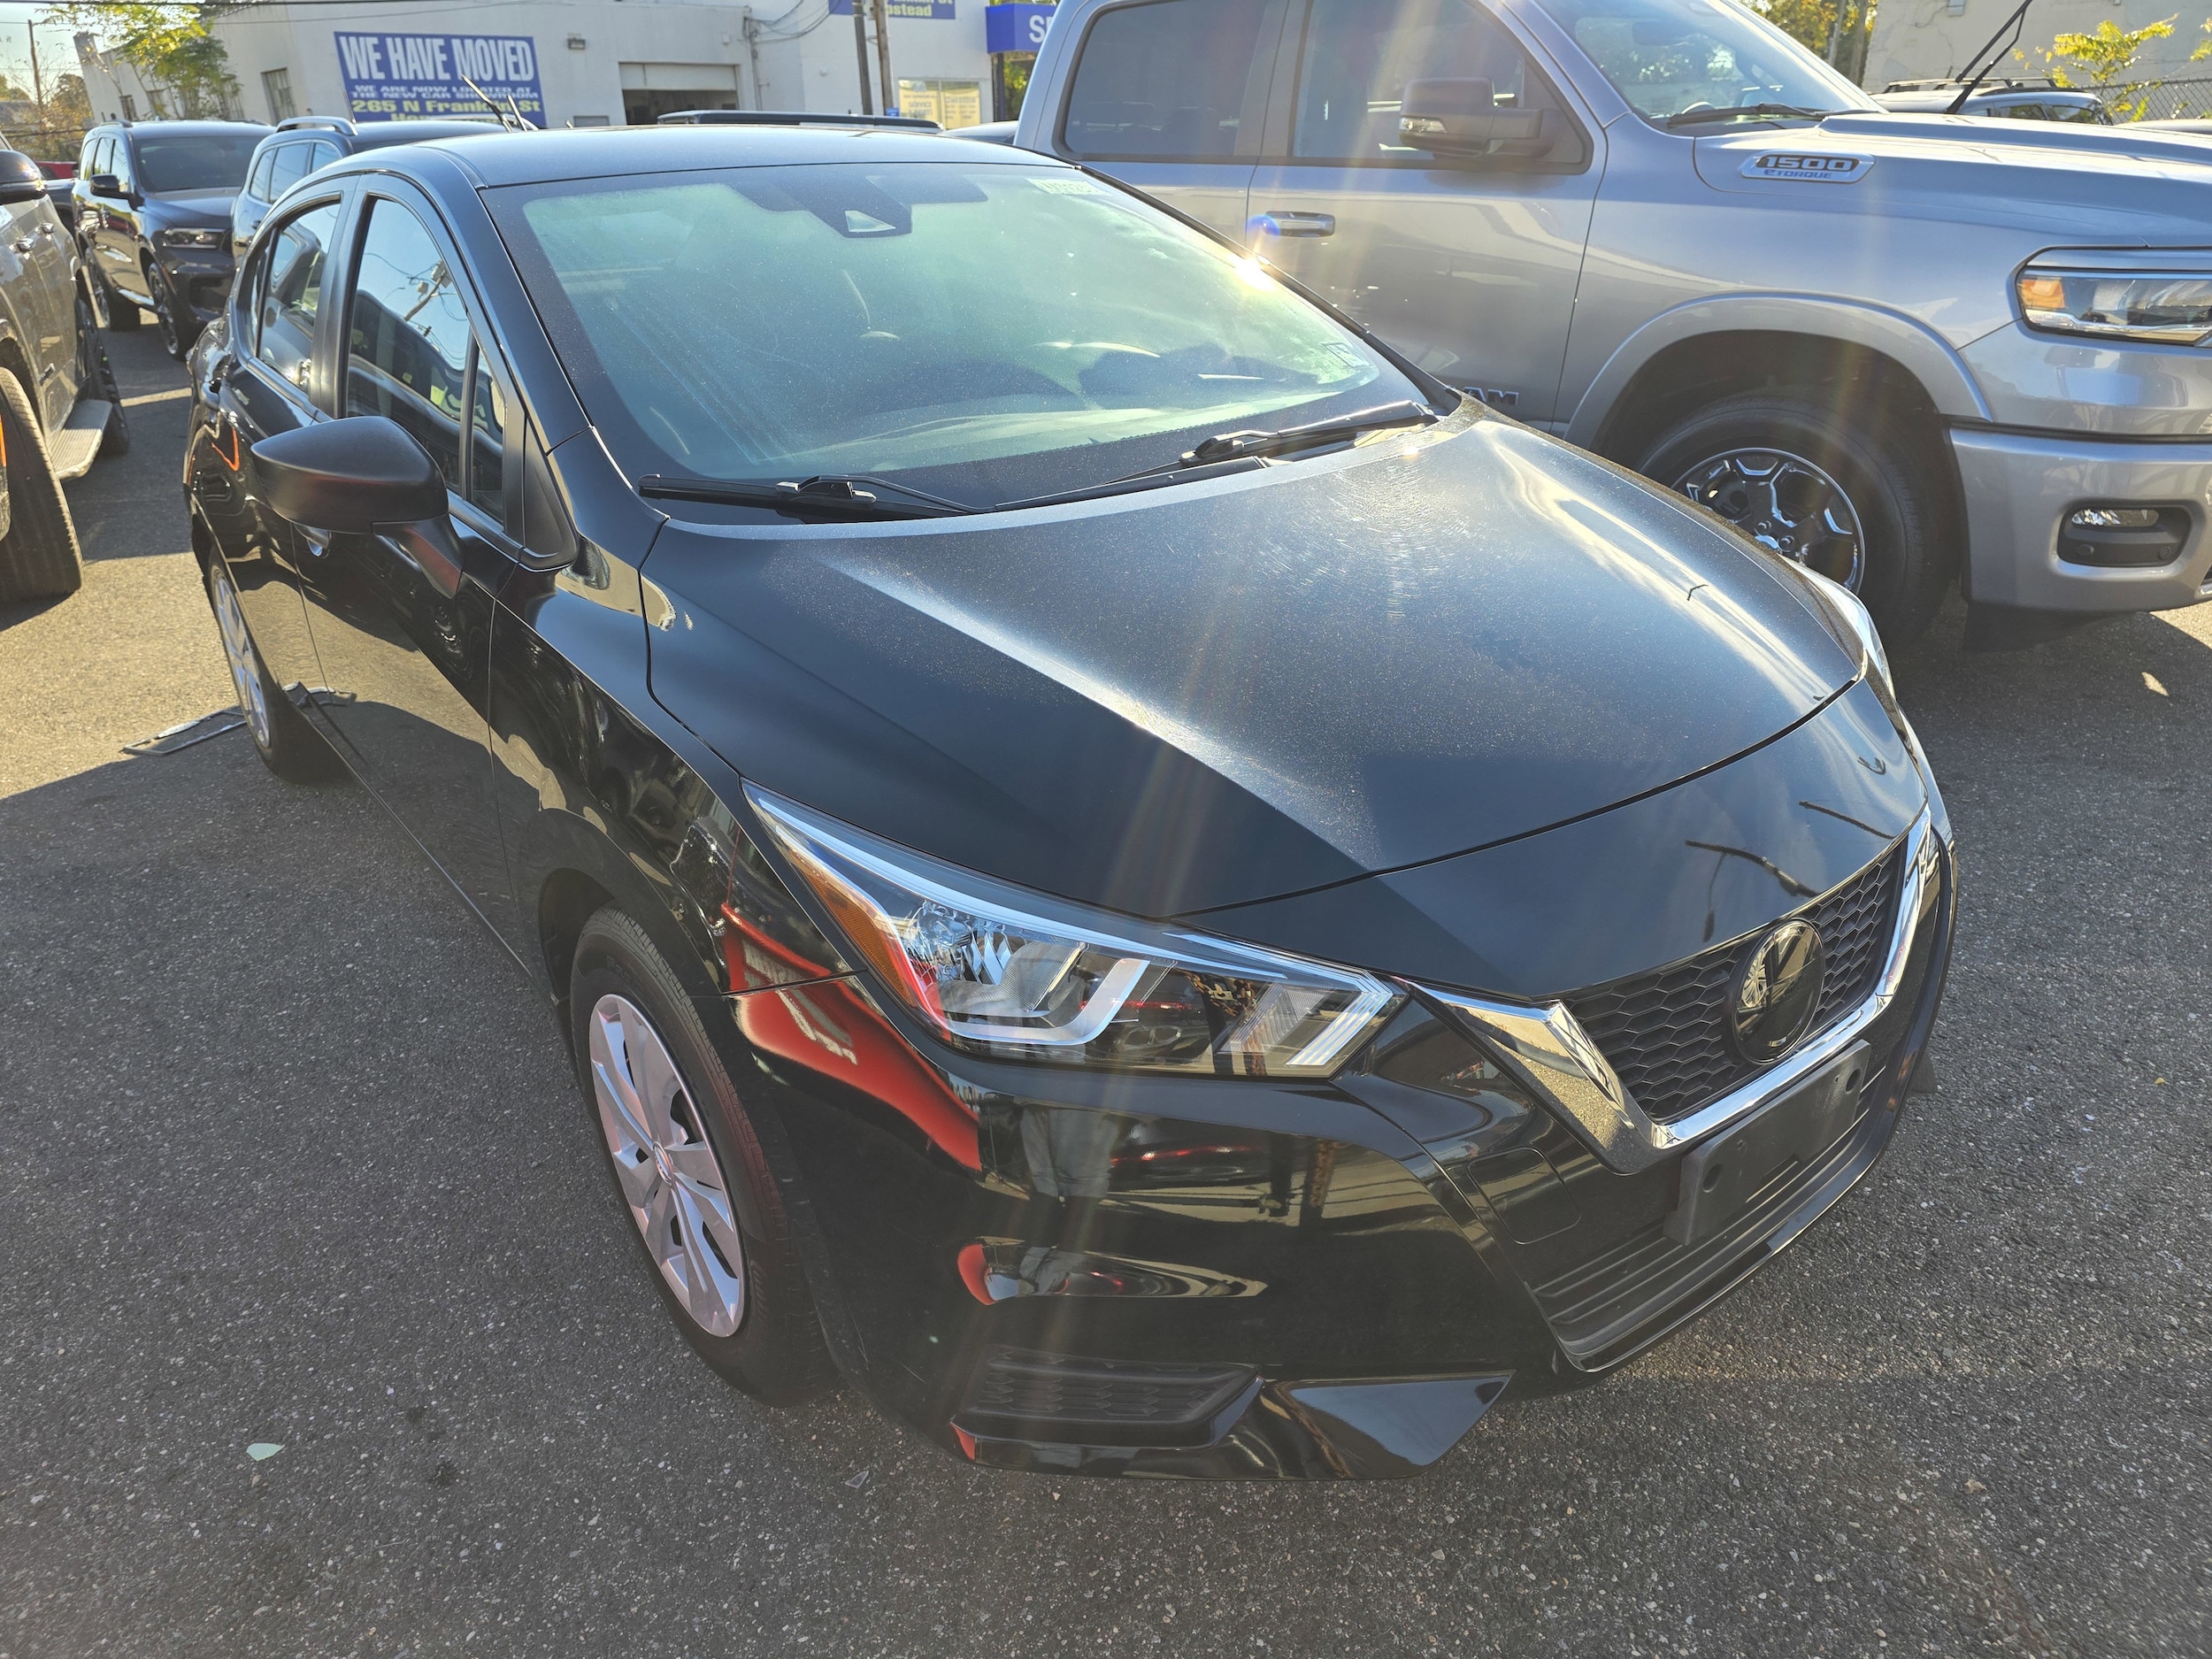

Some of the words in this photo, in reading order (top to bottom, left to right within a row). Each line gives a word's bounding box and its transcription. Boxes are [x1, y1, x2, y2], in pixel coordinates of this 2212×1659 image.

[339, 35, 386, 80] WE
[385, 37, 451, 81] HAVE
[451, 38, 534, 81] MOVED
[351, 100, 397, 112] 265
[403, 100, 420, 112] N
[426, 100, 513, 112] Frankin
[518, 100, 541, 112] St
[1765, 157, 1854, 171] 1500
